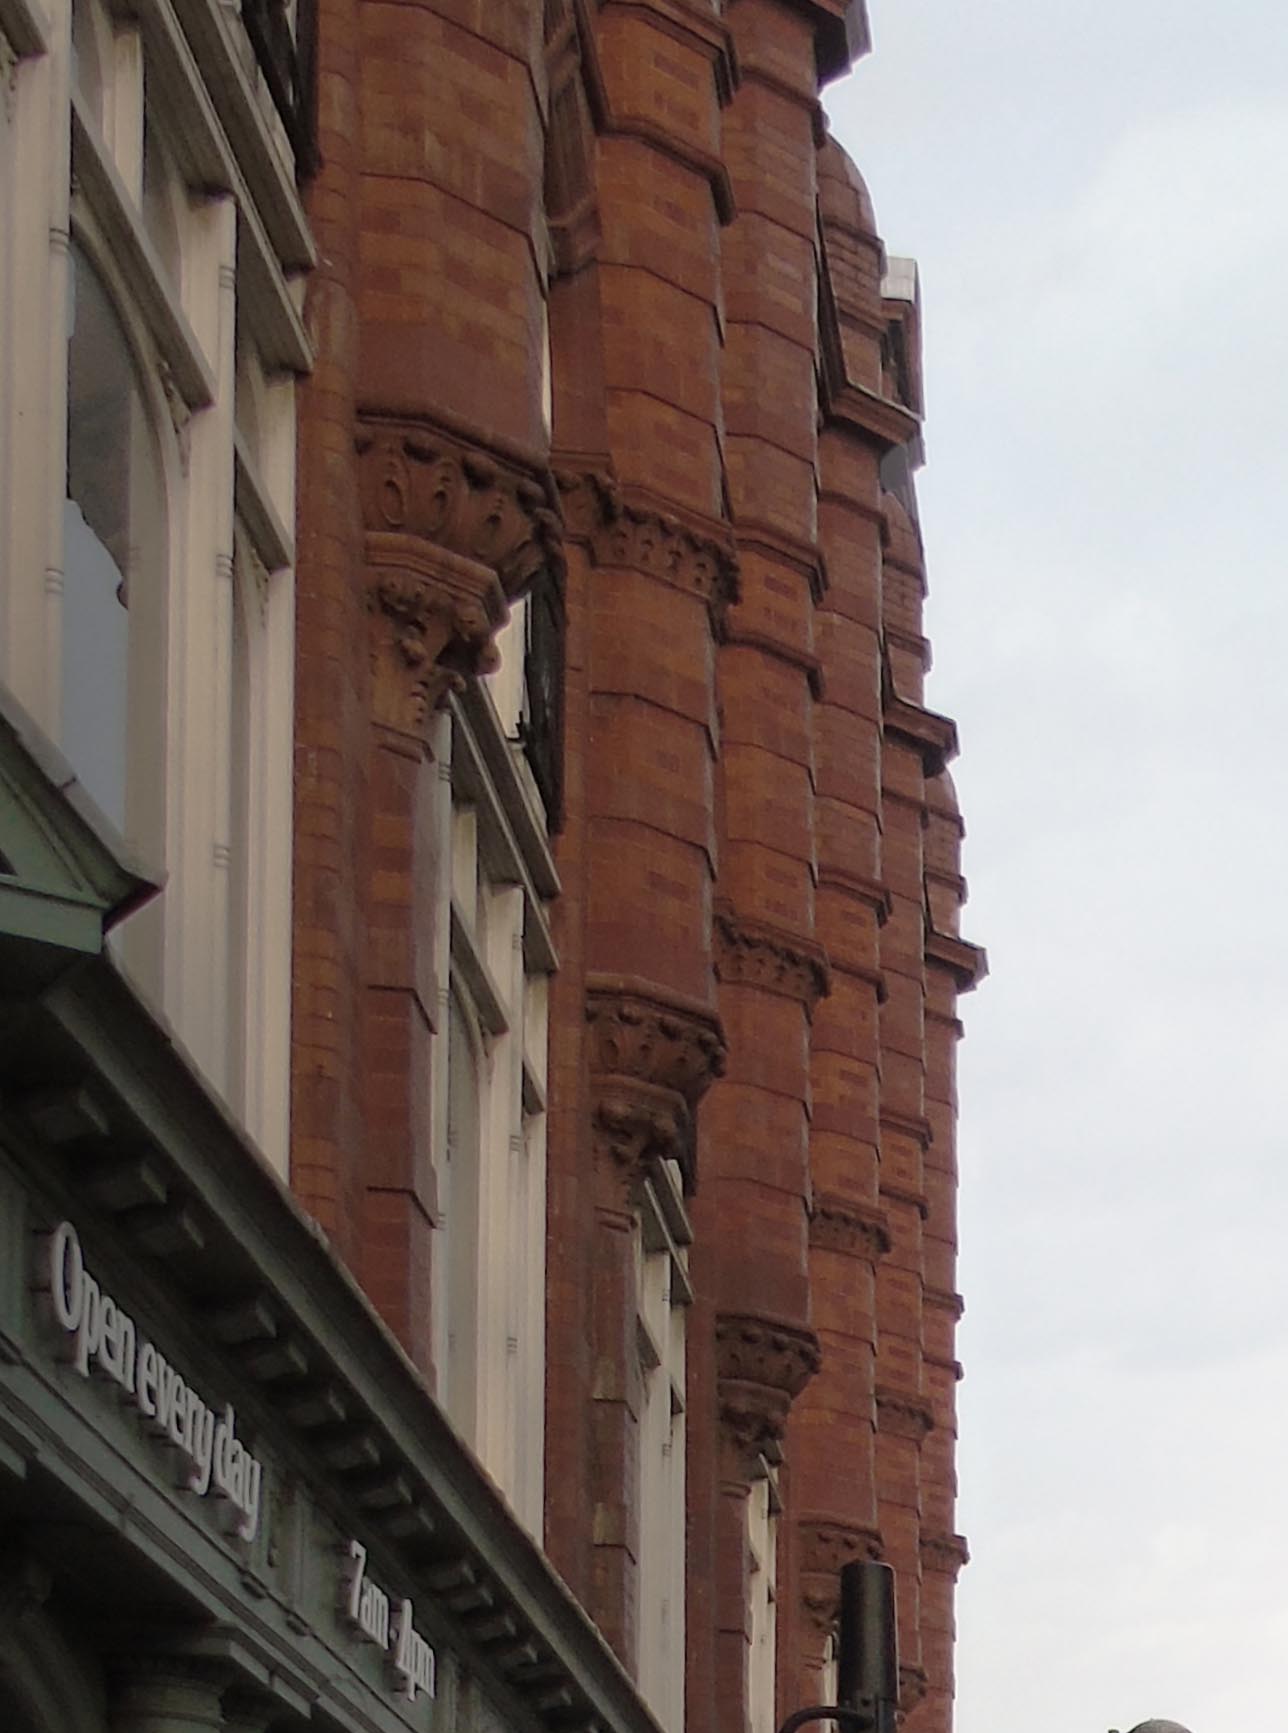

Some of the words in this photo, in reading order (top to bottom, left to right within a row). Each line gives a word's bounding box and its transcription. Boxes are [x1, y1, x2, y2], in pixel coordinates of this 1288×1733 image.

[55, 1221, 136, 1393] Open
[136, 1343, 214, 1496] every
[213, 1403, 261, 1542] day
